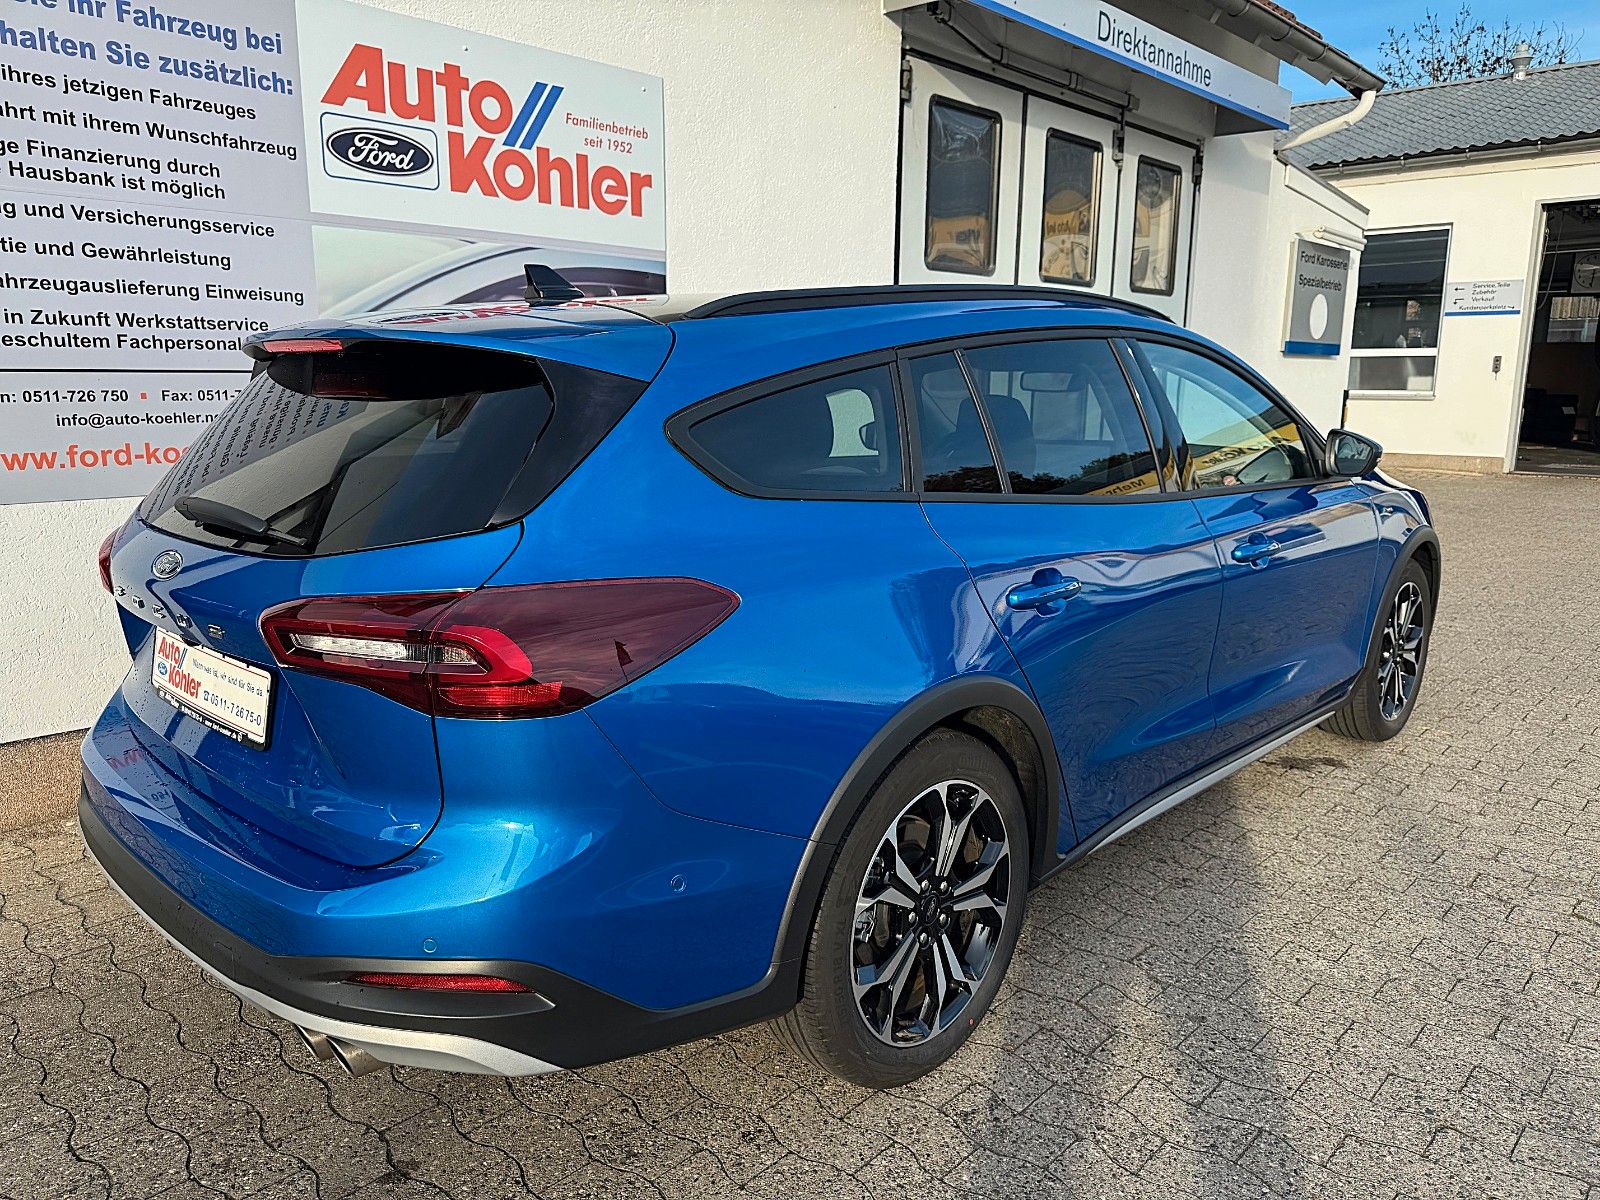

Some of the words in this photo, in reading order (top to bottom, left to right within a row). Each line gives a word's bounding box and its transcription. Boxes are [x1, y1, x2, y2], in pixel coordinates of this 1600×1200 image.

[116, 0, 238, 50] Fahrzeug
[245, 26, 283, 54] bei
[1097, 9, 1212, 88] Direktannahme
[106, 40, 150, 69] Sie
[159, 55, 294, 95] zusätzlich:
[1, 64, 57, 88] ihres
[63, 73, 143, 101] jetzigen
[150, 88, 257, 120] Fahrzeuges
[321, 43, 513, 134] Auto
[0, 101, 37, 121] hrt
[43, 109, 77, 127] mit
[83, 112, 140, 135] ihrem
[146, 121, 298, 160] Wunschfahrzeug
[565, 112, 649, 140] Familienbetrieb
[27, 139, 161, 174] Finanzierung
[167, 157, 221, 178] durch
[346, 132, 415, 171] Ford
[584, 135, 604, 150] seit
[606, 138, 633, 154] 1952
[8, 160, 116, 188] Hausbank
[121, 173, 146, 191] ist
[151, 177, 226, 200] möglich
[24, 203, 65, 219] und
[70, 204, 275, 237] Versicherungsservice
[34, 241, 75, 257] und
[81, 242, 231, 270] Gewährleistung
[1300, 250, 1316, 264] Ford
[1316, 253, 1348, 271] Karosserie
[205, 283, 305, 306] Einweisung
[1298, 273, 1342, 292] Spezialbetrieb
[3, 308, 24, 325] in
[30, 309, 111, 328] Zukunft
[116, 312, 269, 332] Werkstattservice
[1, 331, 111, 348] eschultem
[116, 333, 242, 353] Fachpersonal
[22, 389, 99, 403] 0511-726
[101, 389, 129, 402] 750
[161, 389, 193, 402] Fax:
[158, 636, 181, 665] Auto
